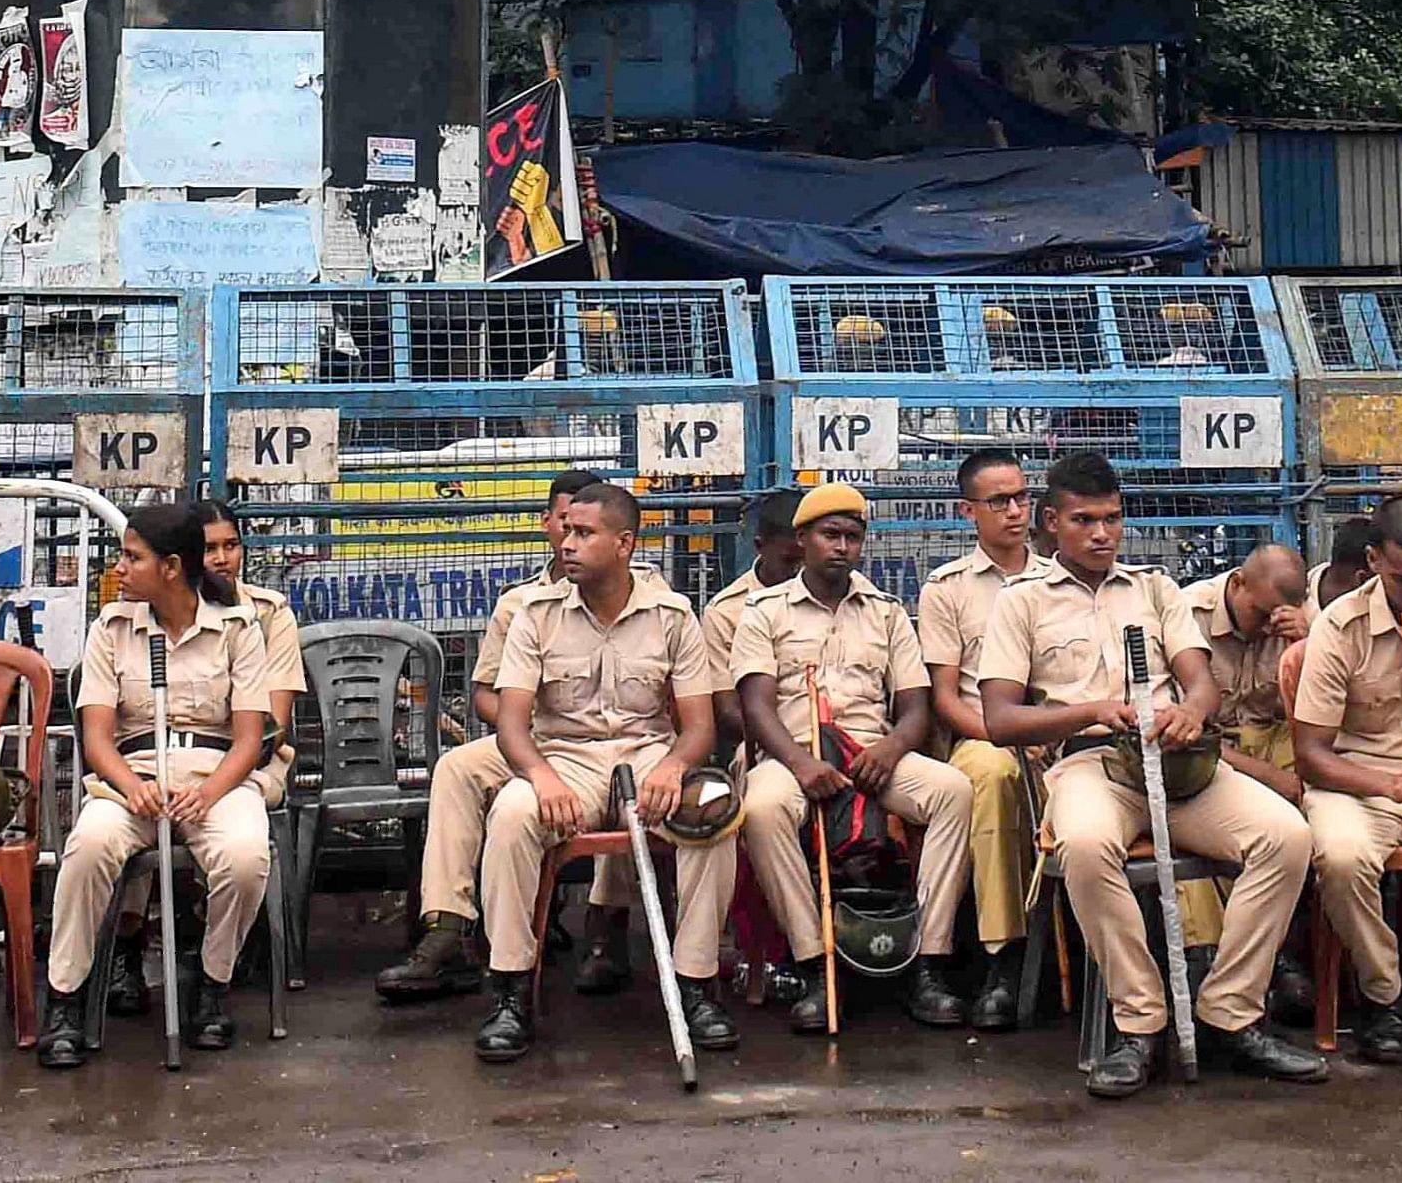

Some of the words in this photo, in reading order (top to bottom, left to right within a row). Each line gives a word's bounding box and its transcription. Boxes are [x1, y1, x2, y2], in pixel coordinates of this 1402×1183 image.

[254, 426, 311, 465] KP
[664, 421, 718, 458] KP
[818, 414, 871, 452] KP
[1205, 413, 1256, 449] KP
[100, 431, 158, 470] KP
[289, 573, 423, 622] KOLKATA
